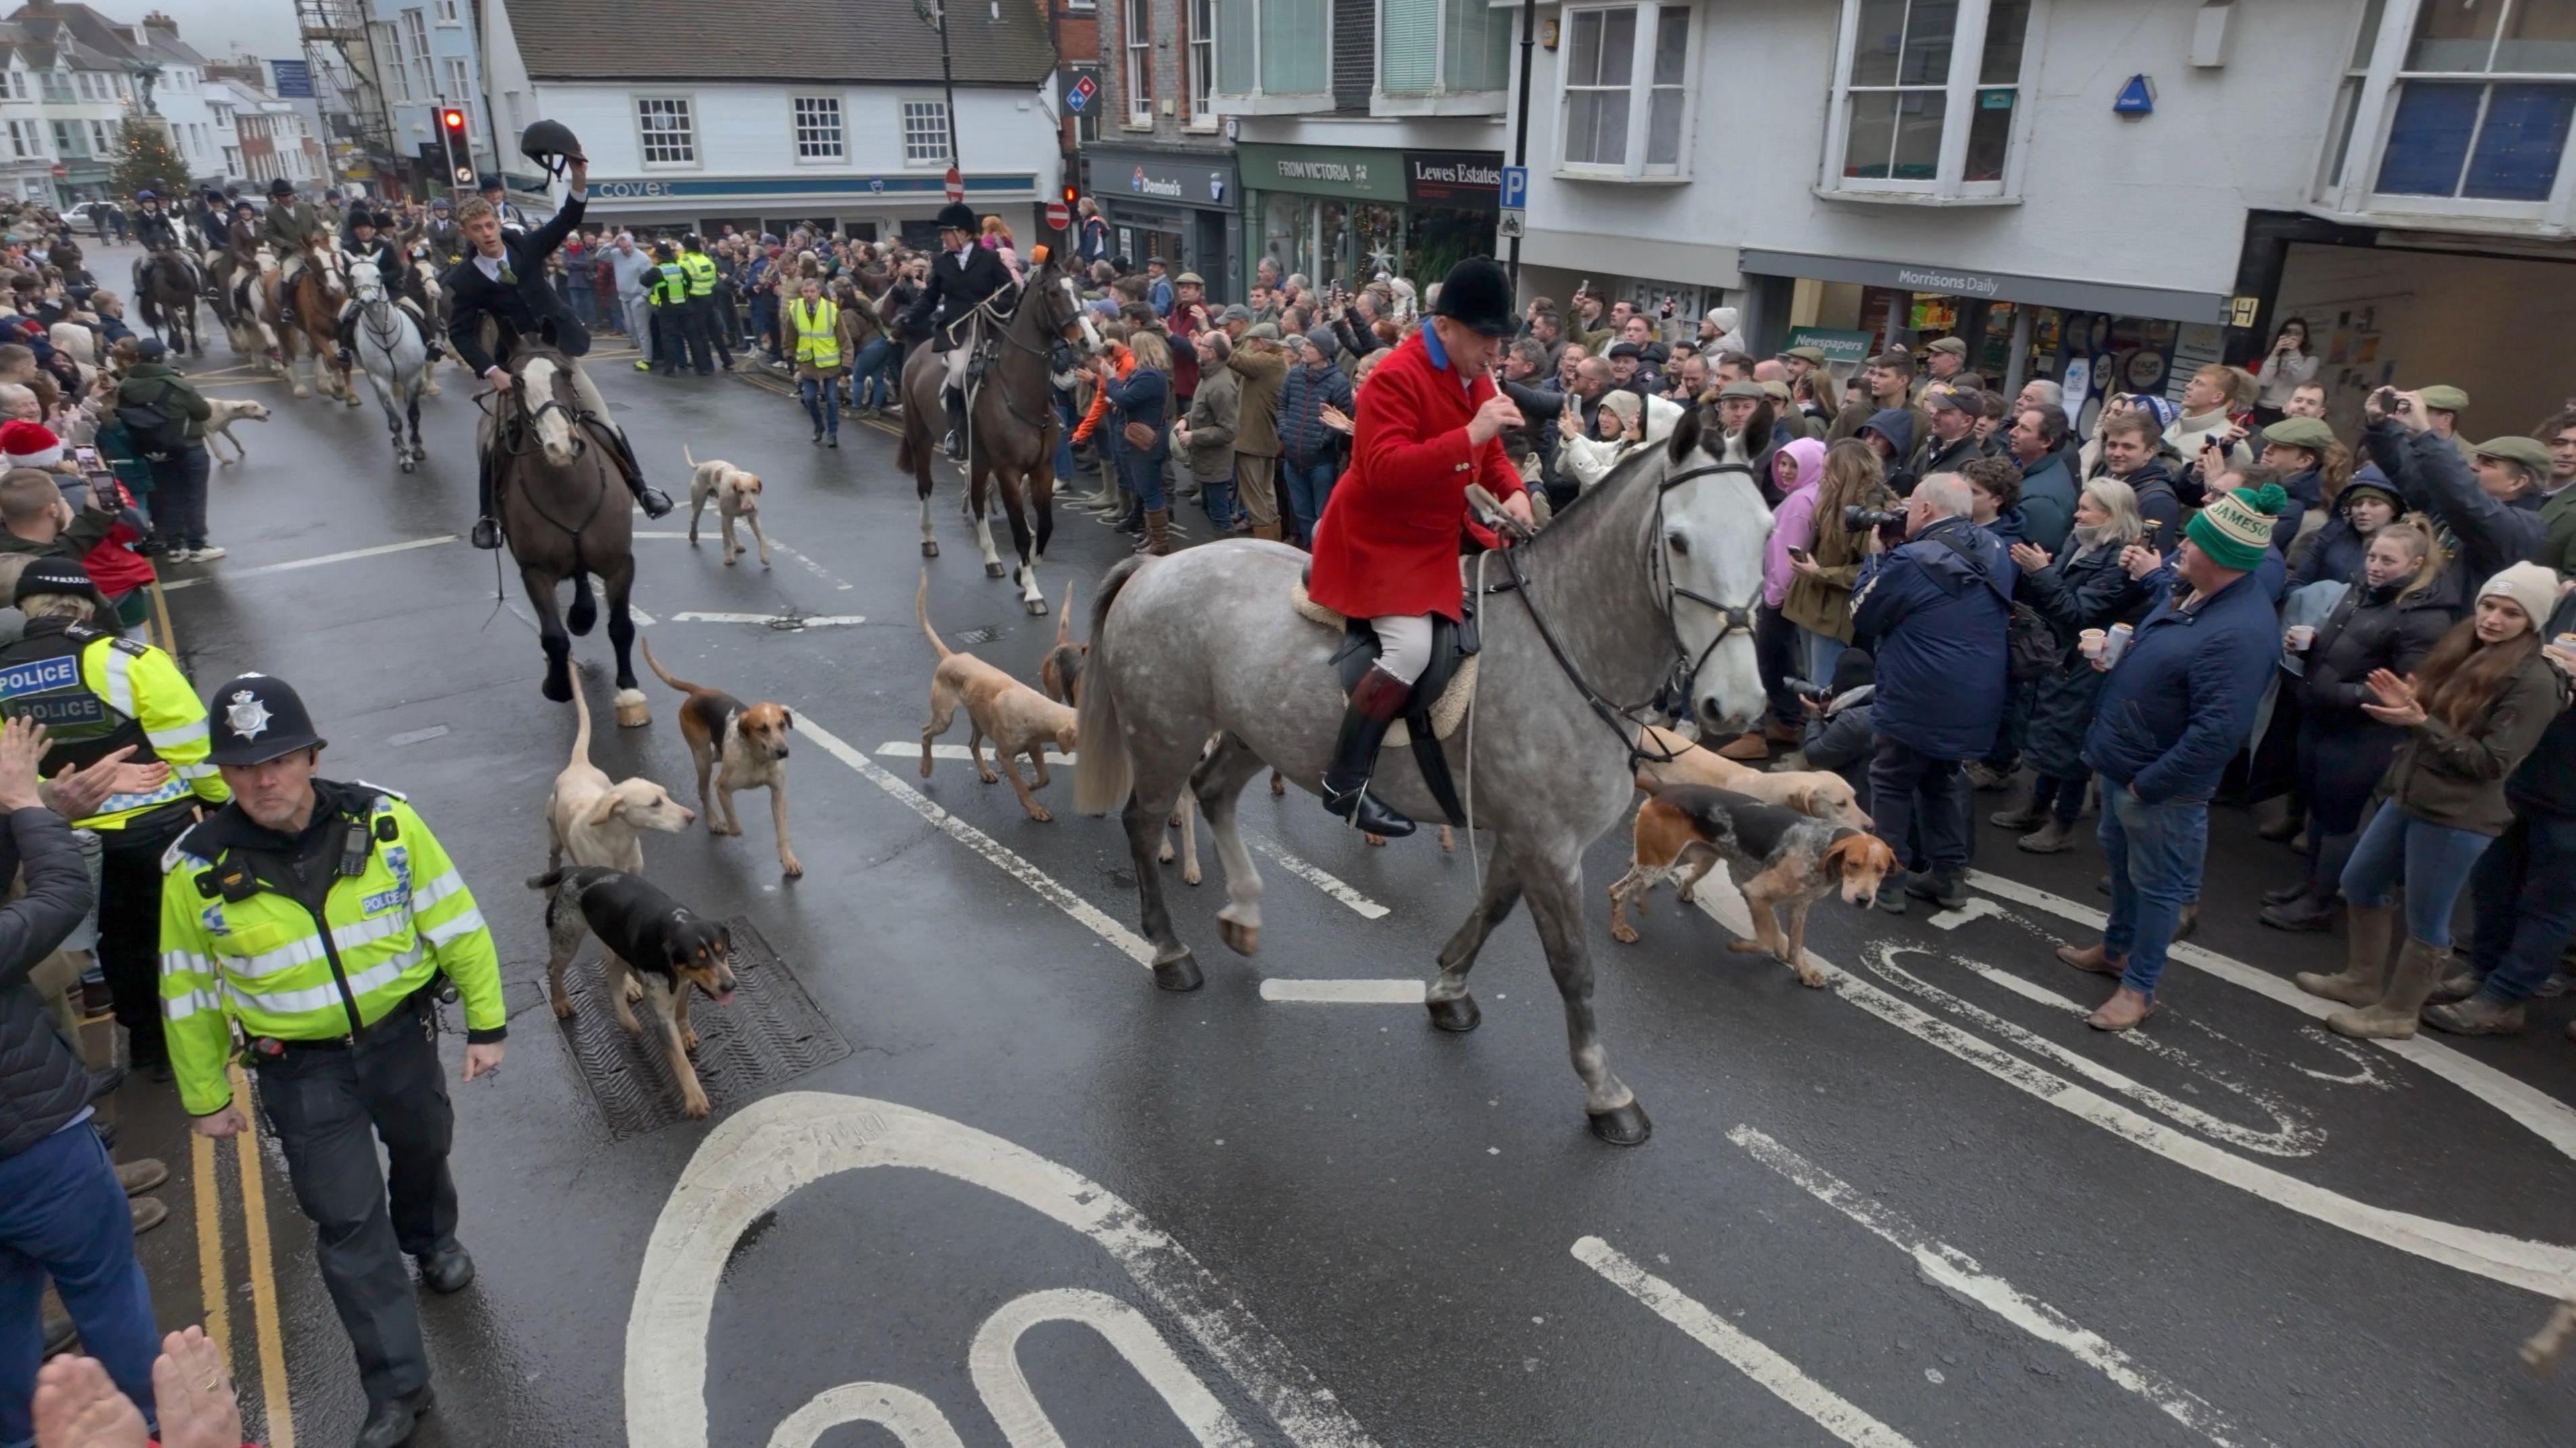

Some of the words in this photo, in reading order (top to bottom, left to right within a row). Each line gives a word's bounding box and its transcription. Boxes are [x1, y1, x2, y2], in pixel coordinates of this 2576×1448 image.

[1277, 161, 1305, 178] FROM
[1305, 163, 1351, 181] VICTORIA
[1415, 161, 1456, 182] Lewes
[1456, 164, 1501, 185] Estates
[599, 182, 674, 198] covet
[1142, 177, 1181, 196] Domino's
[1506, 171, 1524, 205] P
[1898, 270, 1965, 289] Morrisons
[1966, 276, 1999, 296] Daily
[2233, 300, 2254, 324] H
[1794, 333, 1864, 353] Newspapers
[0, 663, 72, 692] POLICE
[18, 700, 98, 720] POLICE
[364, 891, 400, 911] POLICE
